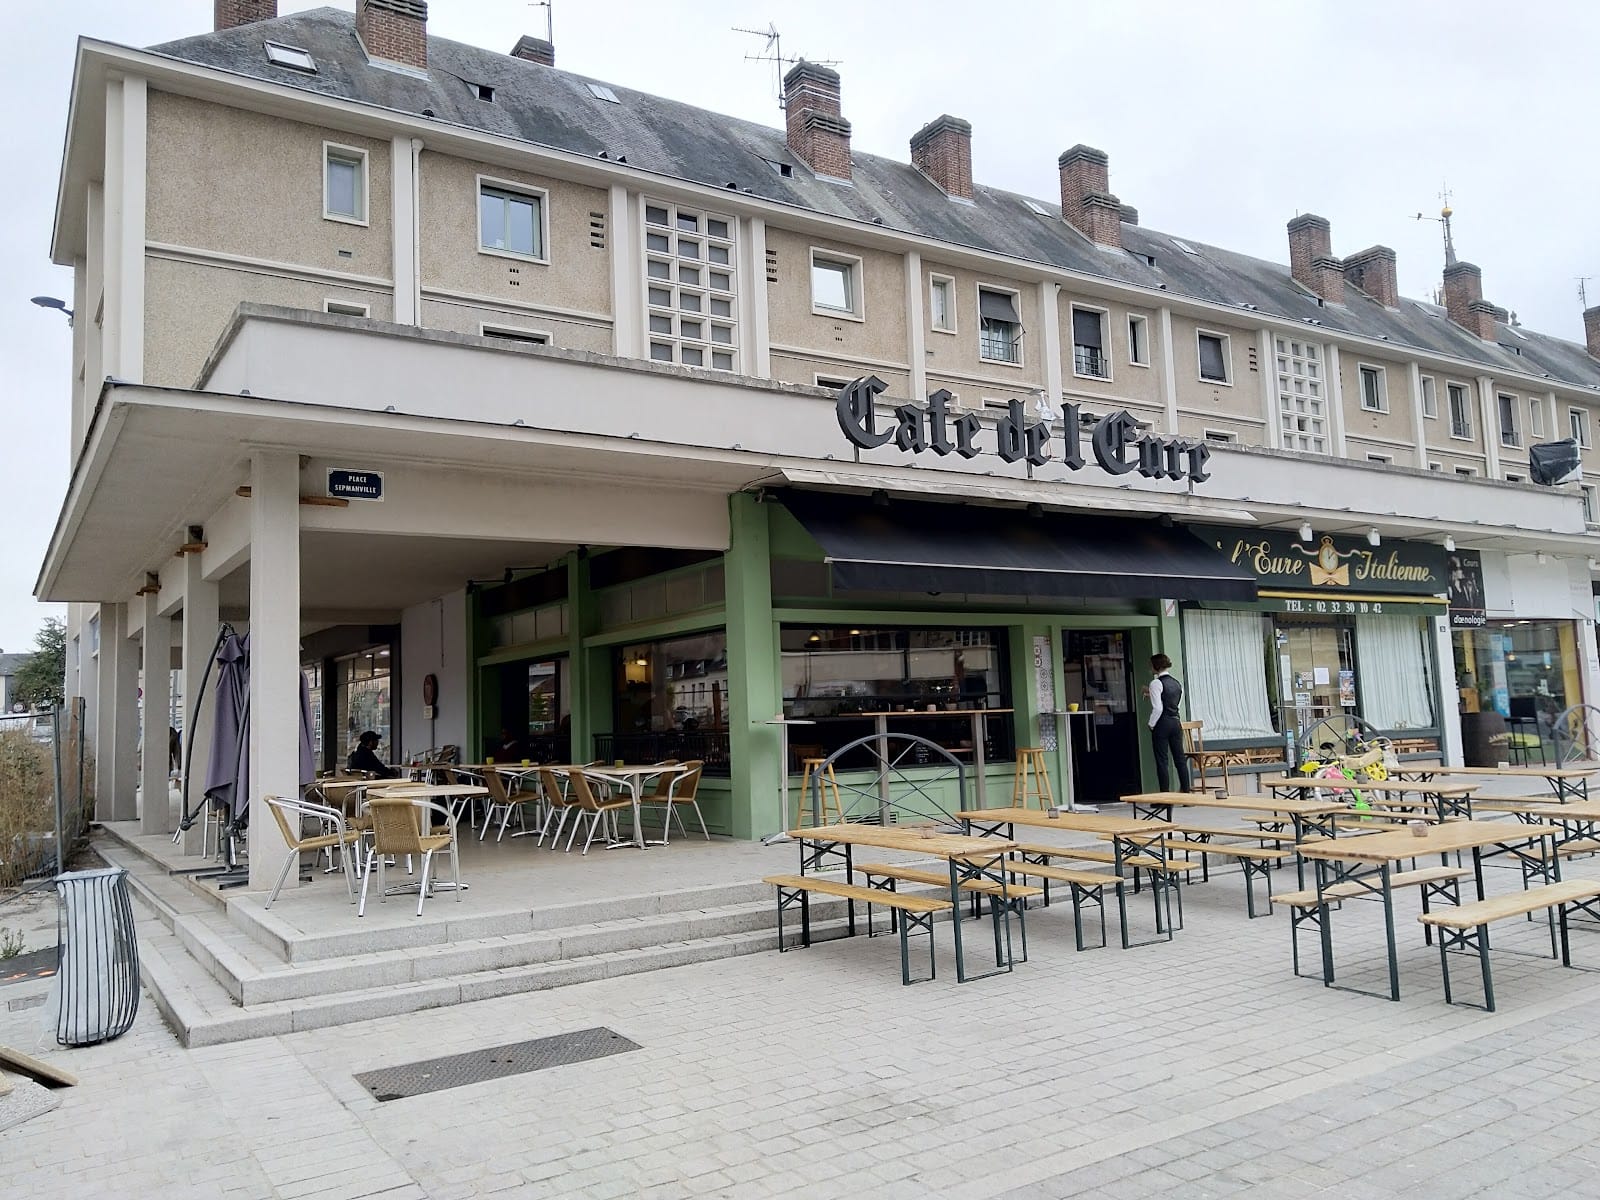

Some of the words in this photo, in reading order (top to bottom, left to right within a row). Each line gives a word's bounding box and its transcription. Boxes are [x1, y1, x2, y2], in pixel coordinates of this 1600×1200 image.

[997, 399, 1051, 467] de
[348, 475, 367, 483] PLACE
[334, 484, 377, 494] SEPMANVILLE
[1231, 540, 1305, 575] l'Eure
[1355, 550, 1436, 582] Italienne
[1285, 600, 1304, 611] TEL
[1316, 602, 1327, 613] 02
[1331, 602, 1341, 613] 32
[1345, 602, 1355, 613] 30
[1360, 602, 1369, 613] 10
[1372, 603, 1382, 613] 42
